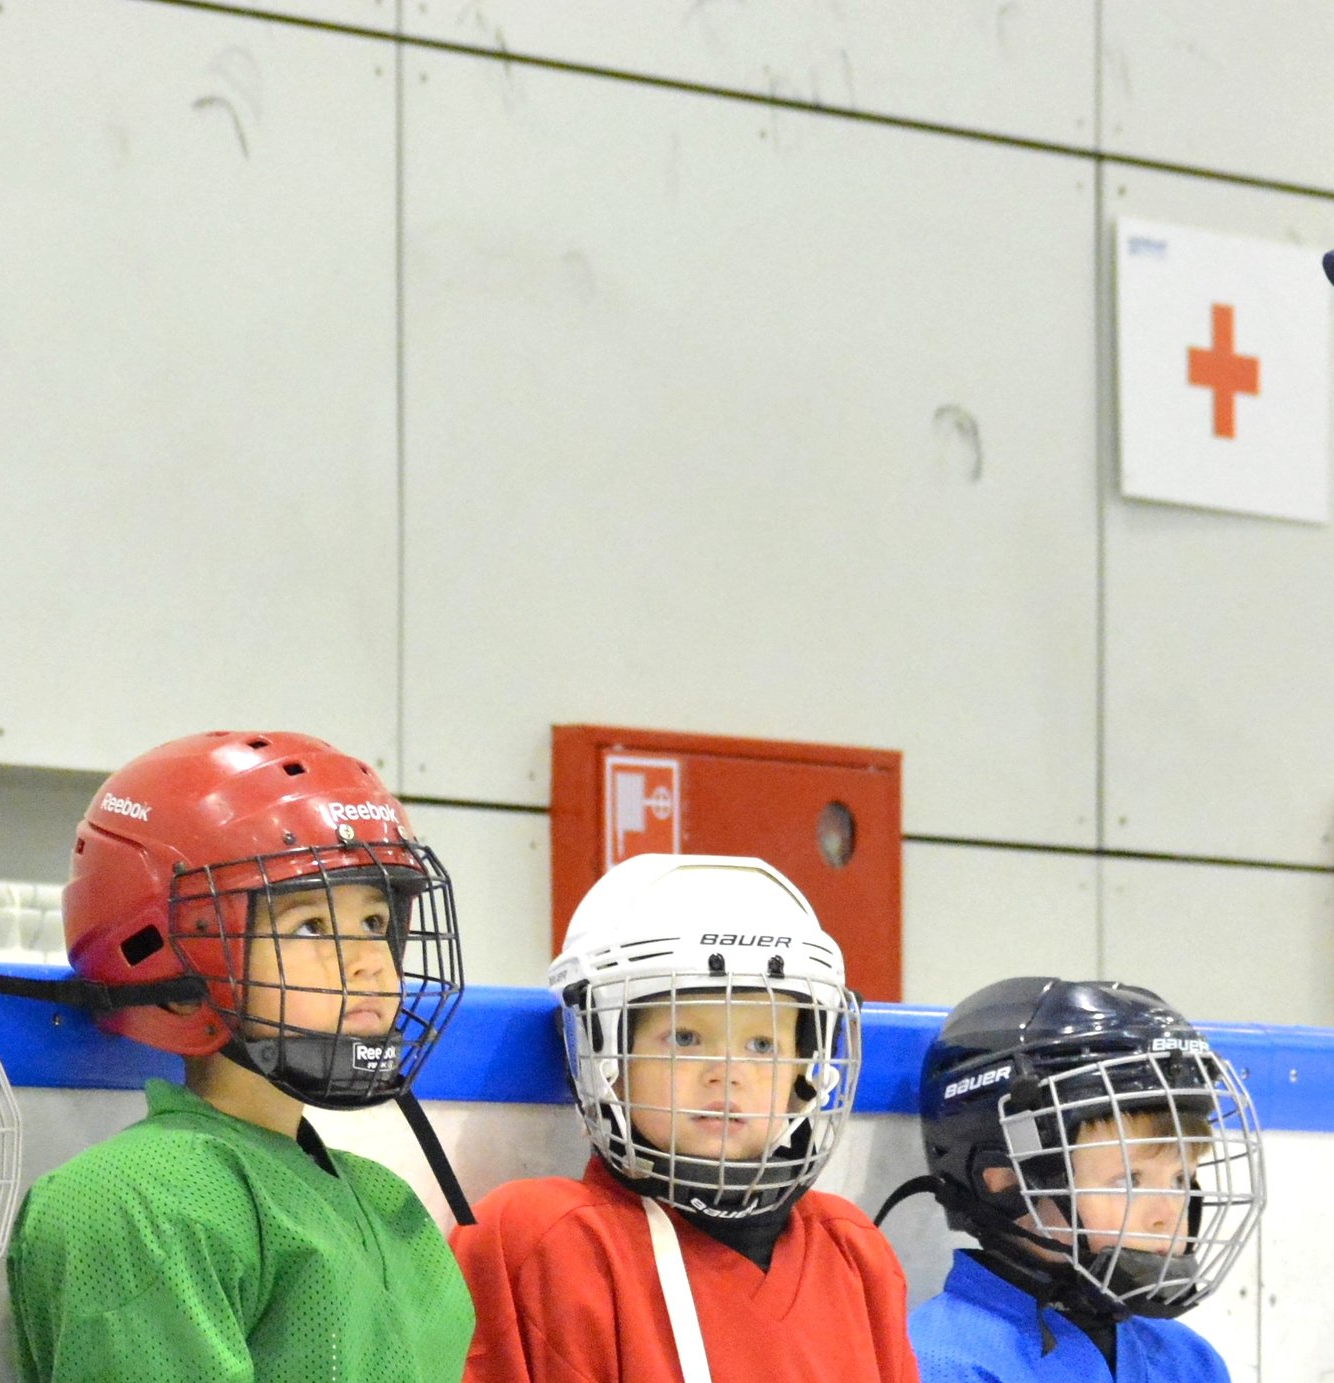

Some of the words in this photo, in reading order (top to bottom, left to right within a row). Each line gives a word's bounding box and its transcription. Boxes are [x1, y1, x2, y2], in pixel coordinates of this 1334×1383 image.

[100, 792, 153, 821] Reebok
[328, 801, 398, 823] Reebok
[700, 933, 792, 949] BAUER
[944, 1066, 1010, 1098] BAUER
